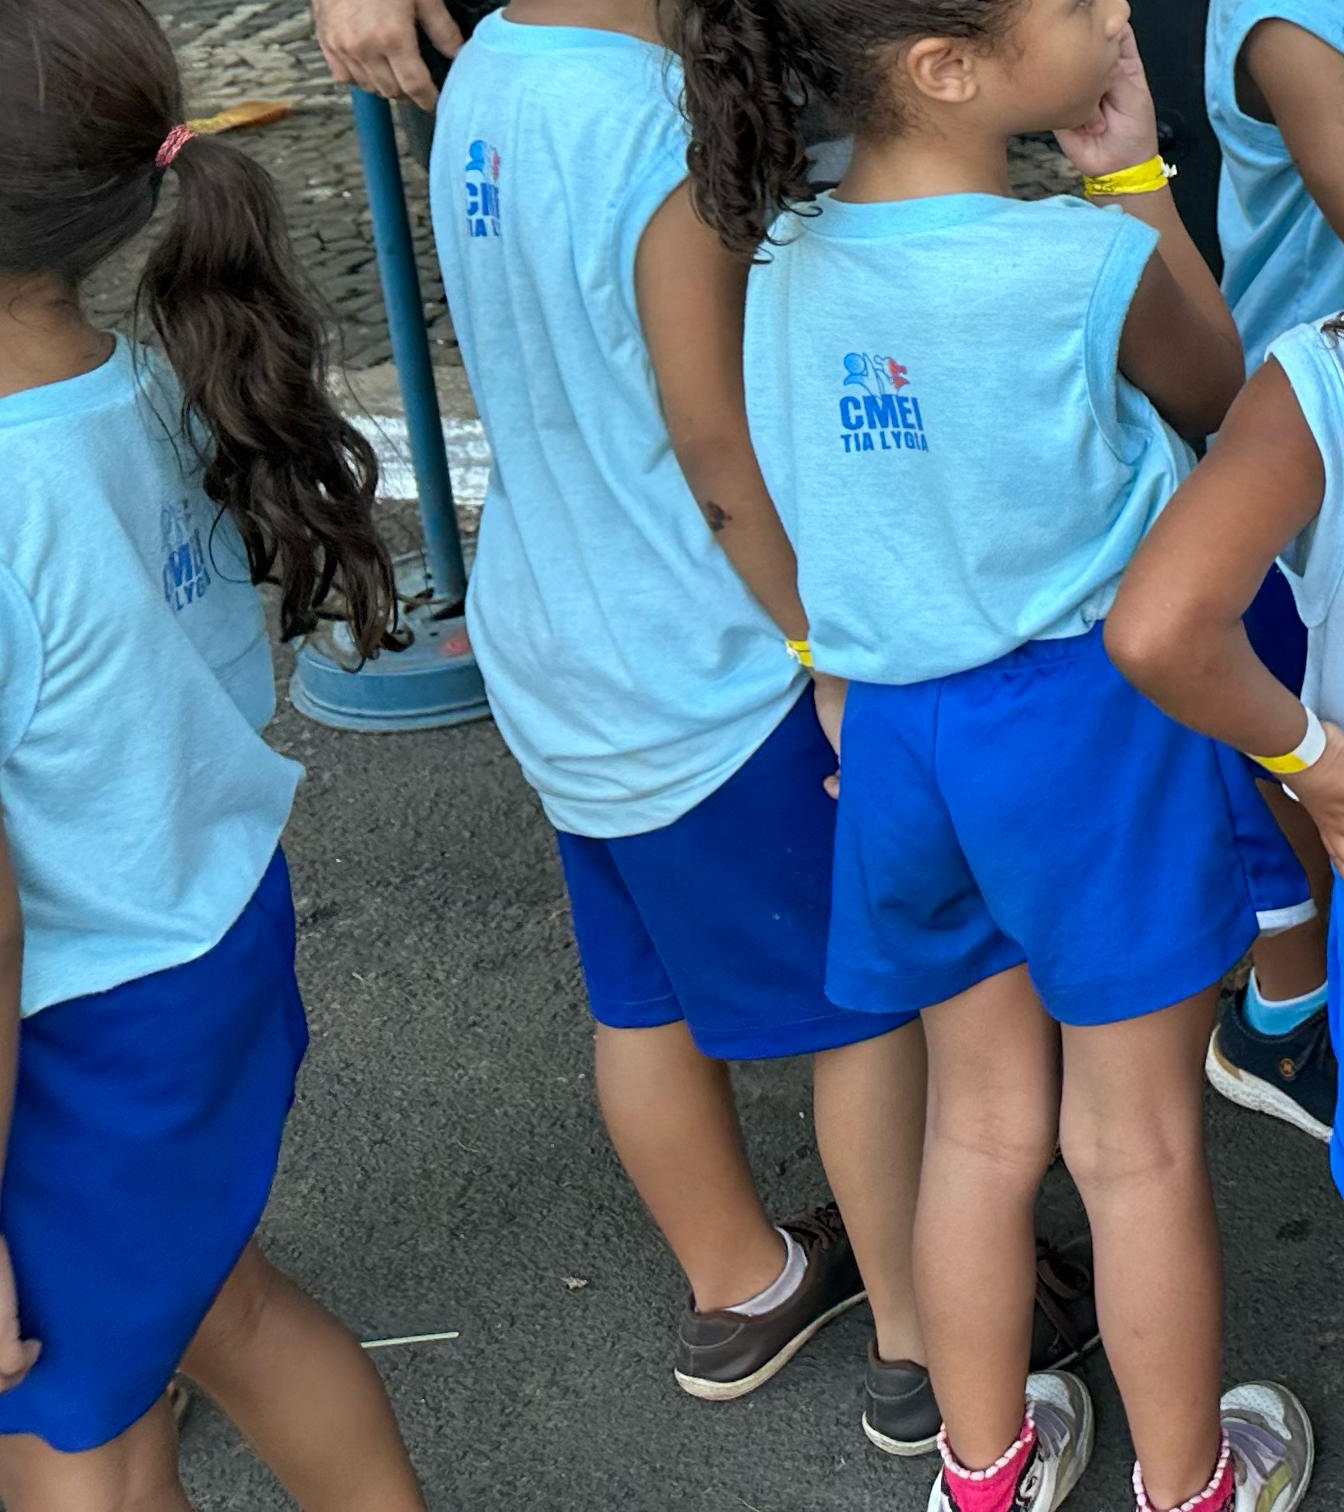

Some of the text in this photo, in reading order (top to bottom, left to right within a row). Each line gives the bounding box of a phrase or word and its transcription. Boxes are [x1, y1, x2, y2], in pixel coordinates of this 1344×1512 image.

[840, 394, 924, 431] CMEI
[841, 431, 929, 453] TIA LYGIA
